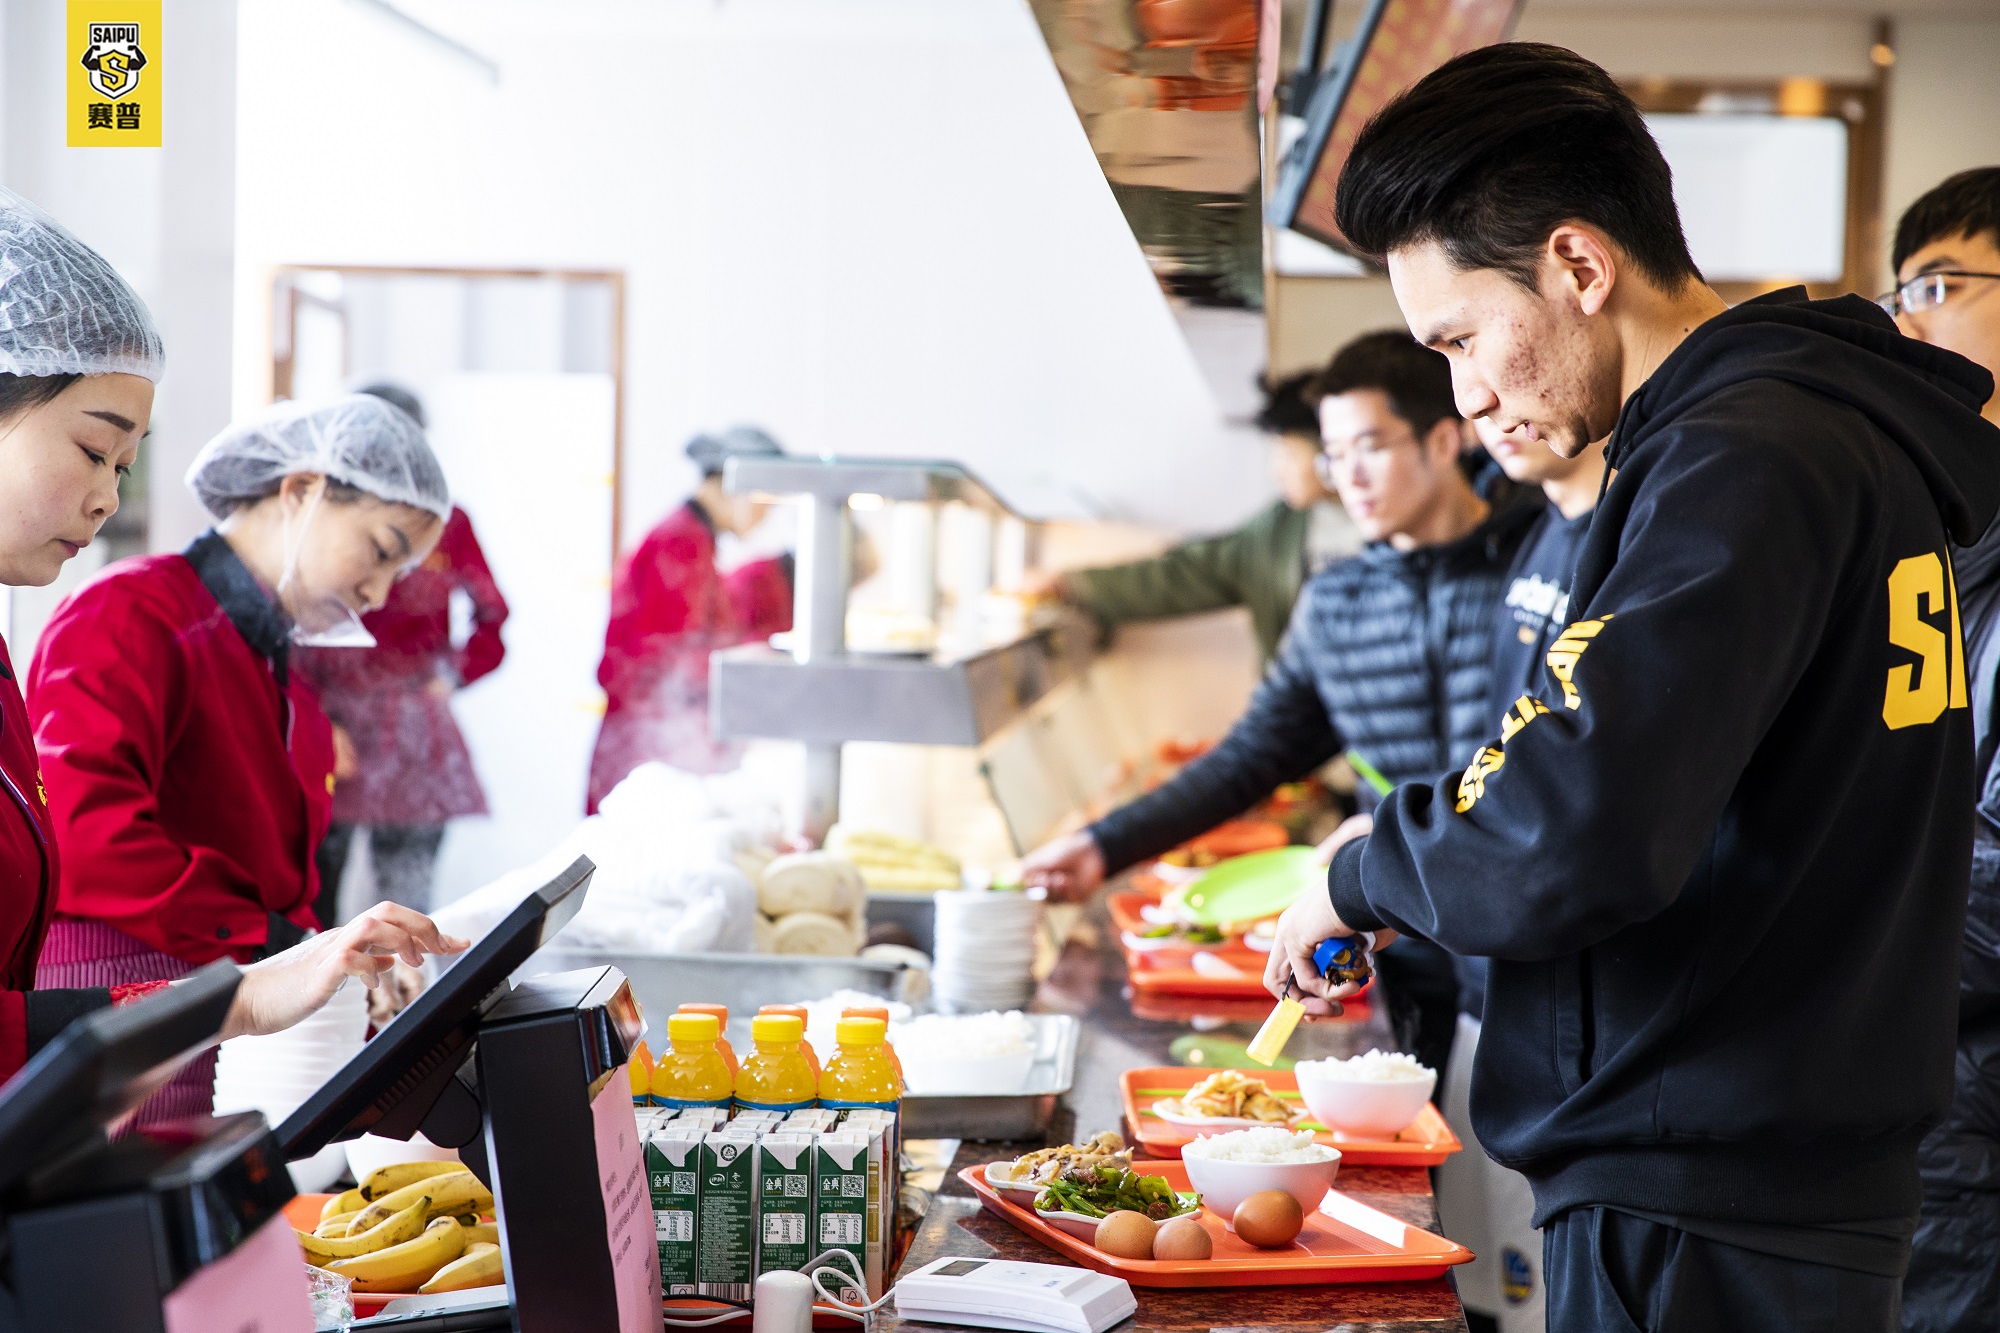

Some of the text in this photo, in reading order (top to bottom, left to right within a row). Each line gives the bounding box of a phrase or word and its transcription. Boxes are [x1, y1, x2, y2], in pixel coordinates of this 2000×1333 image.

[653, 1174, 671, 1188] 金典
[765, 1177, 782, 1191] 金典
[822, 1177, 840, 1191] 金典
